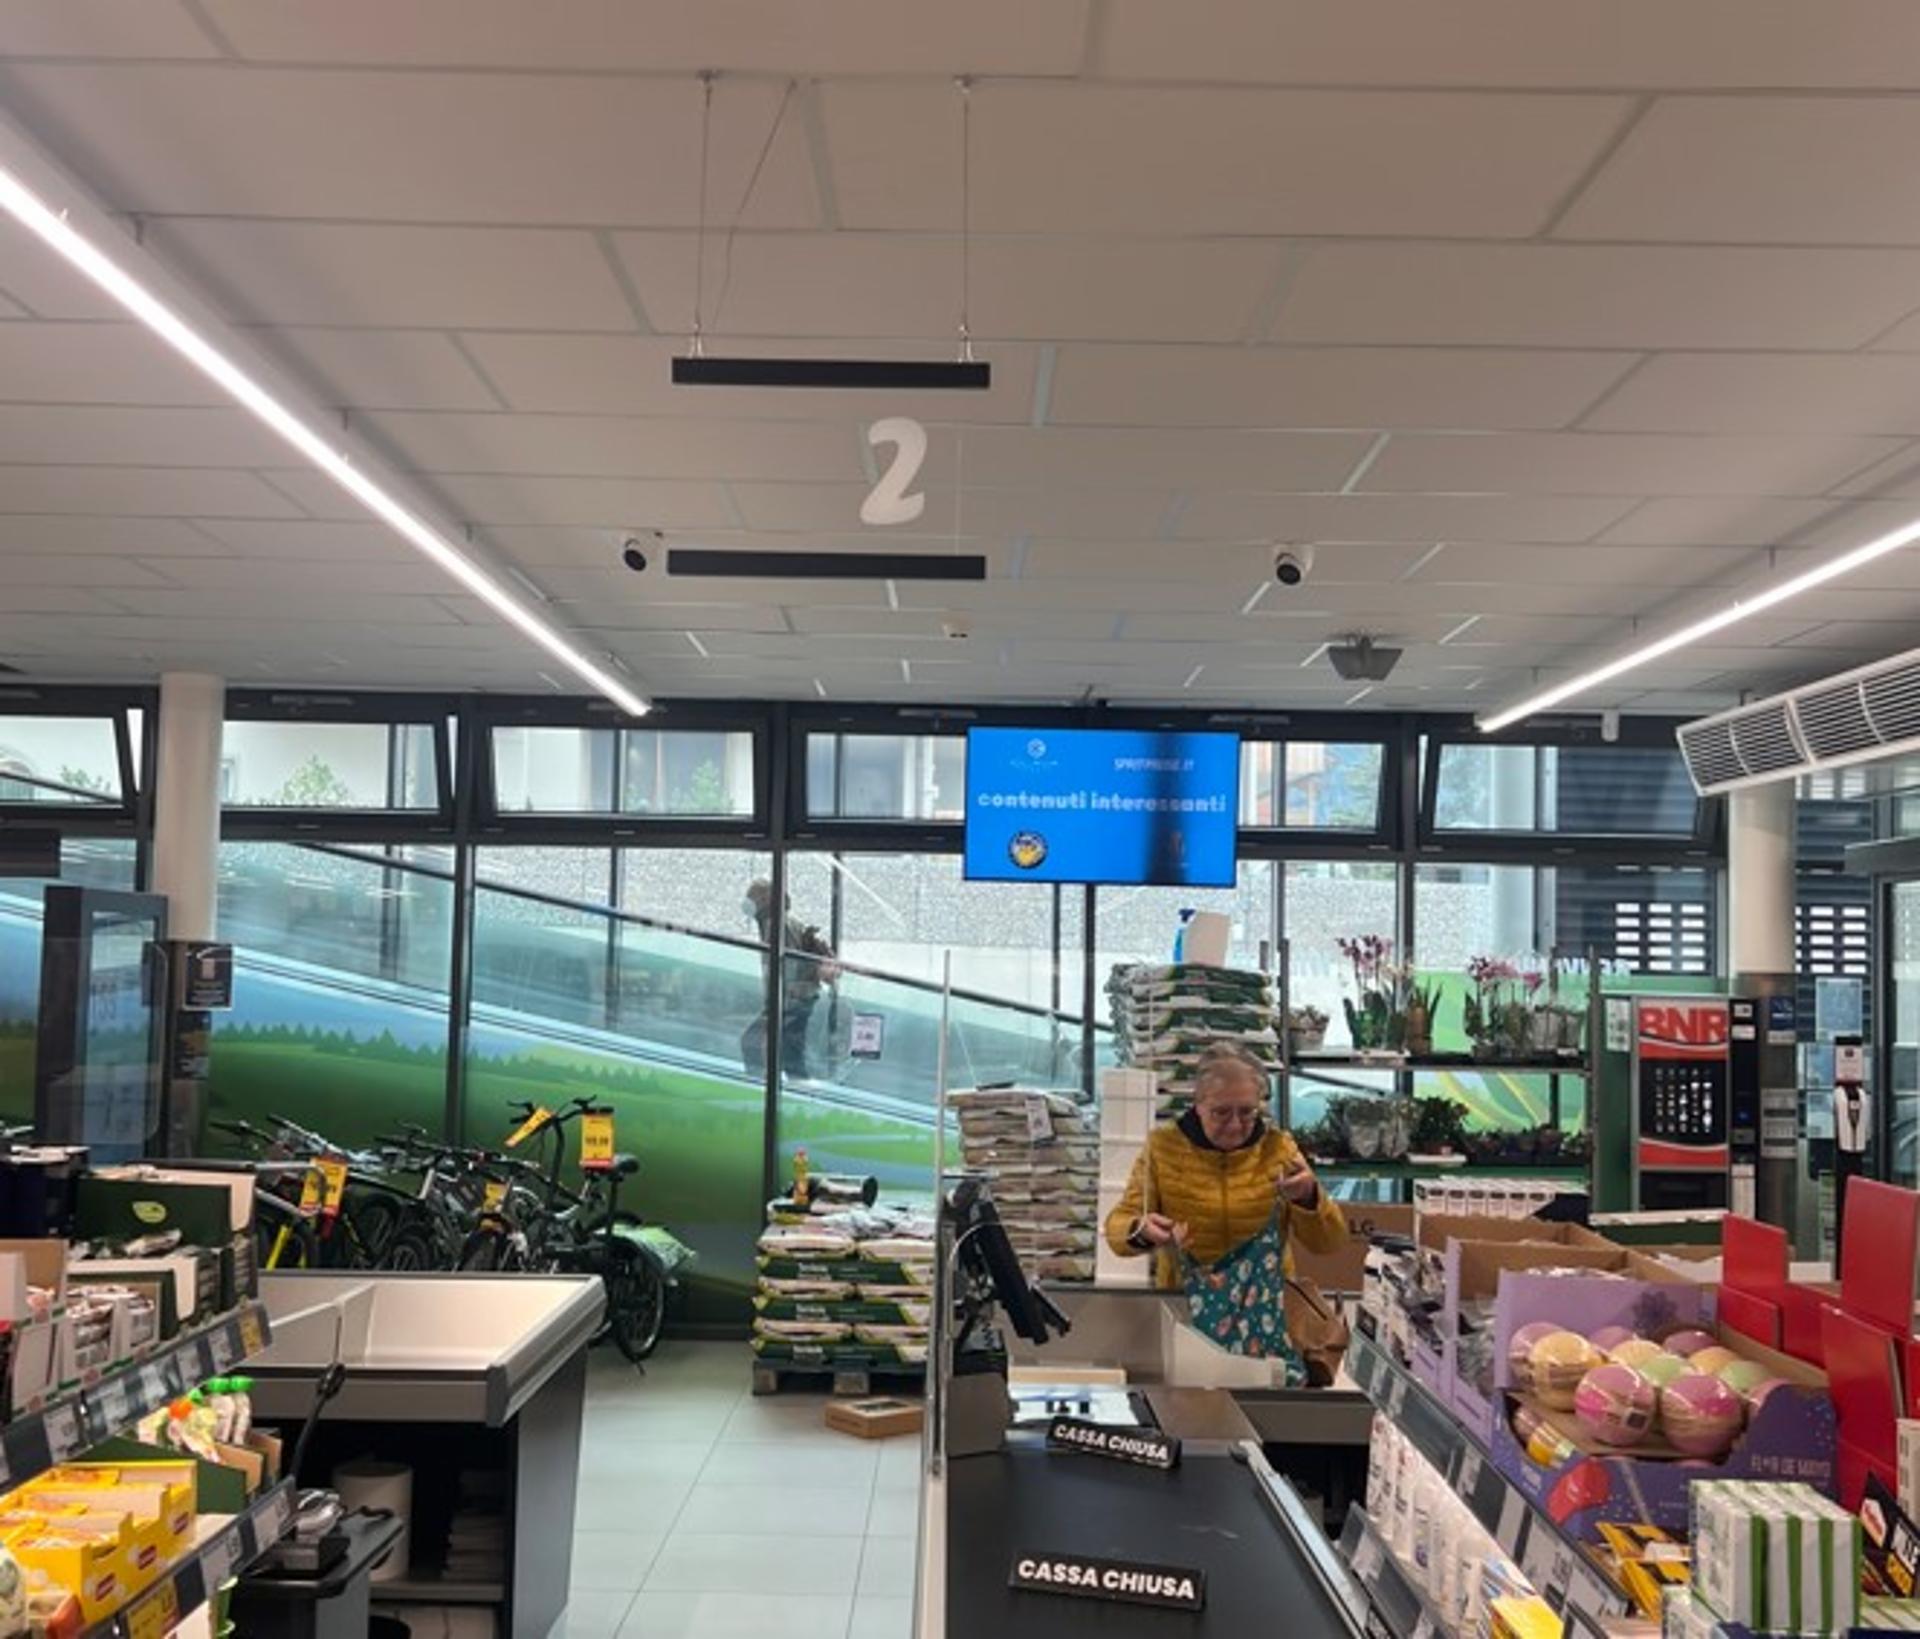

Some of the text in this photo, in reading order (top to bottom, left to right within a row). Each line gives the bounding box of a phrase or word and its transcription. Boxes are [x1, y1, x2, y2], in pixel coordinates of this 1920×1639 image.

[860, 417, 927, 525] 2
[978, 789, 1227, 813] contenuti interessanti
[1054, 1423, 1169, 1461] CASSA CHIUSA
[1018, 1559, 1195, 1600] CASSA CHIUSA
